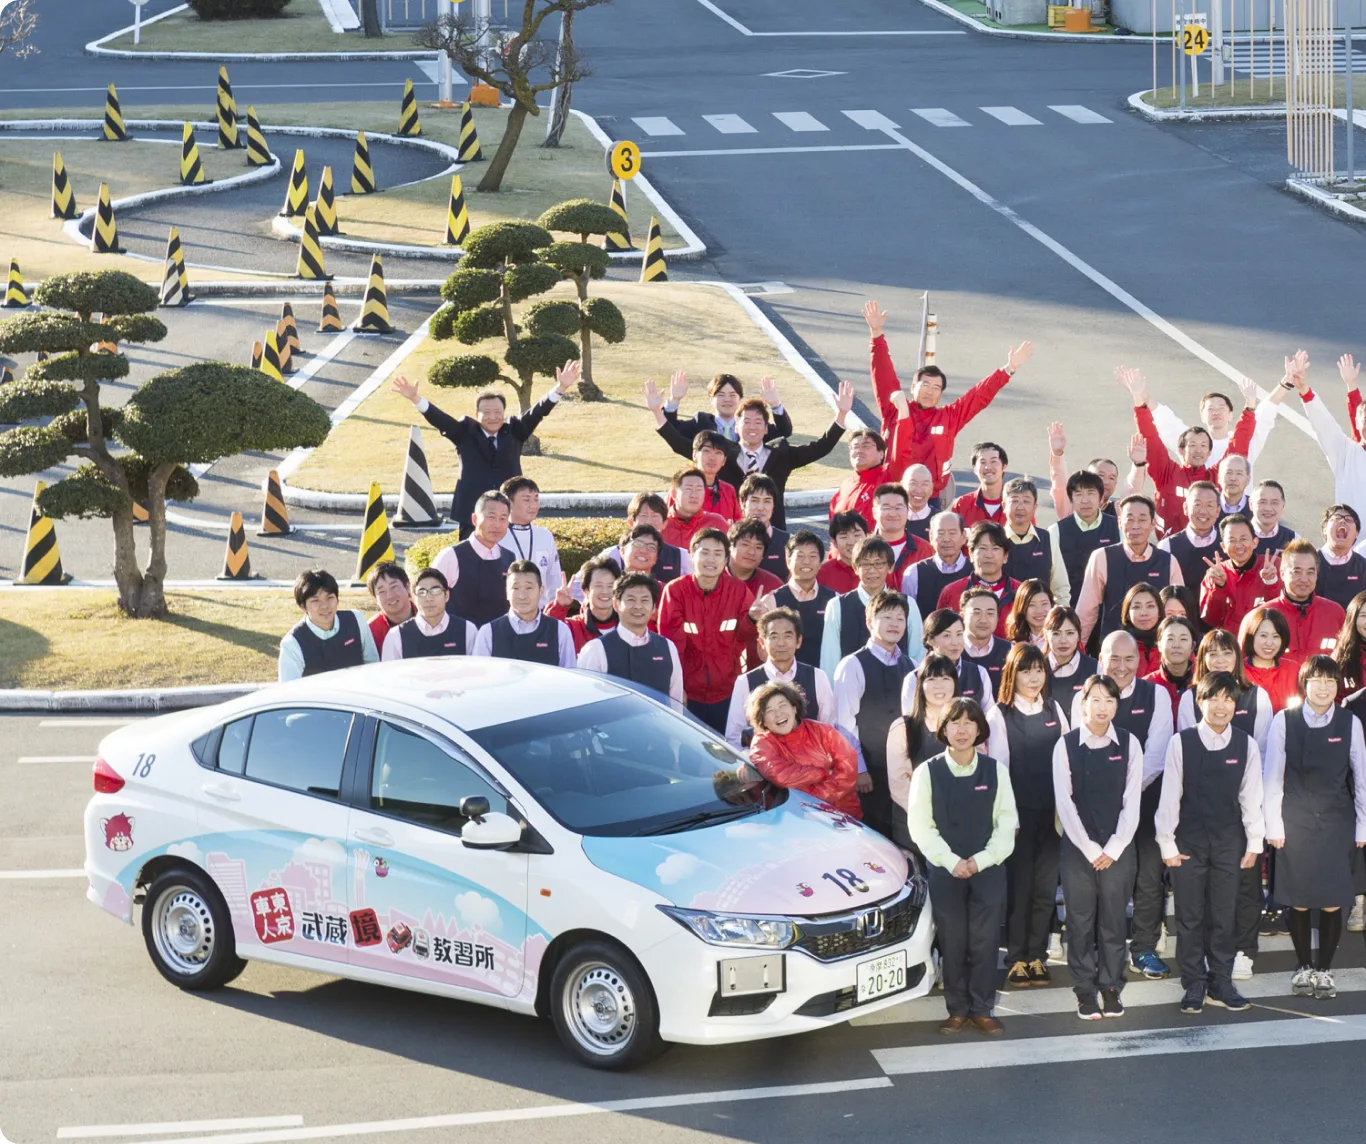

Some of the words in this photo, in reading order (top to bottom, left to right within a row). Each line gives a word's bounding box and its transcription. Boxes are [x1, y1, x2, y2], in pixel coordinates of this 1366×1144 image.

[1184, 30, 1205, 49] 24
[621, 147, 633, 172] 3
[132, 752, 157, 778] 18
[822, 868, 870, 897] 18
[433, 937, 495, 970] 教習所
[868, 967, 904, 995] 20-20
